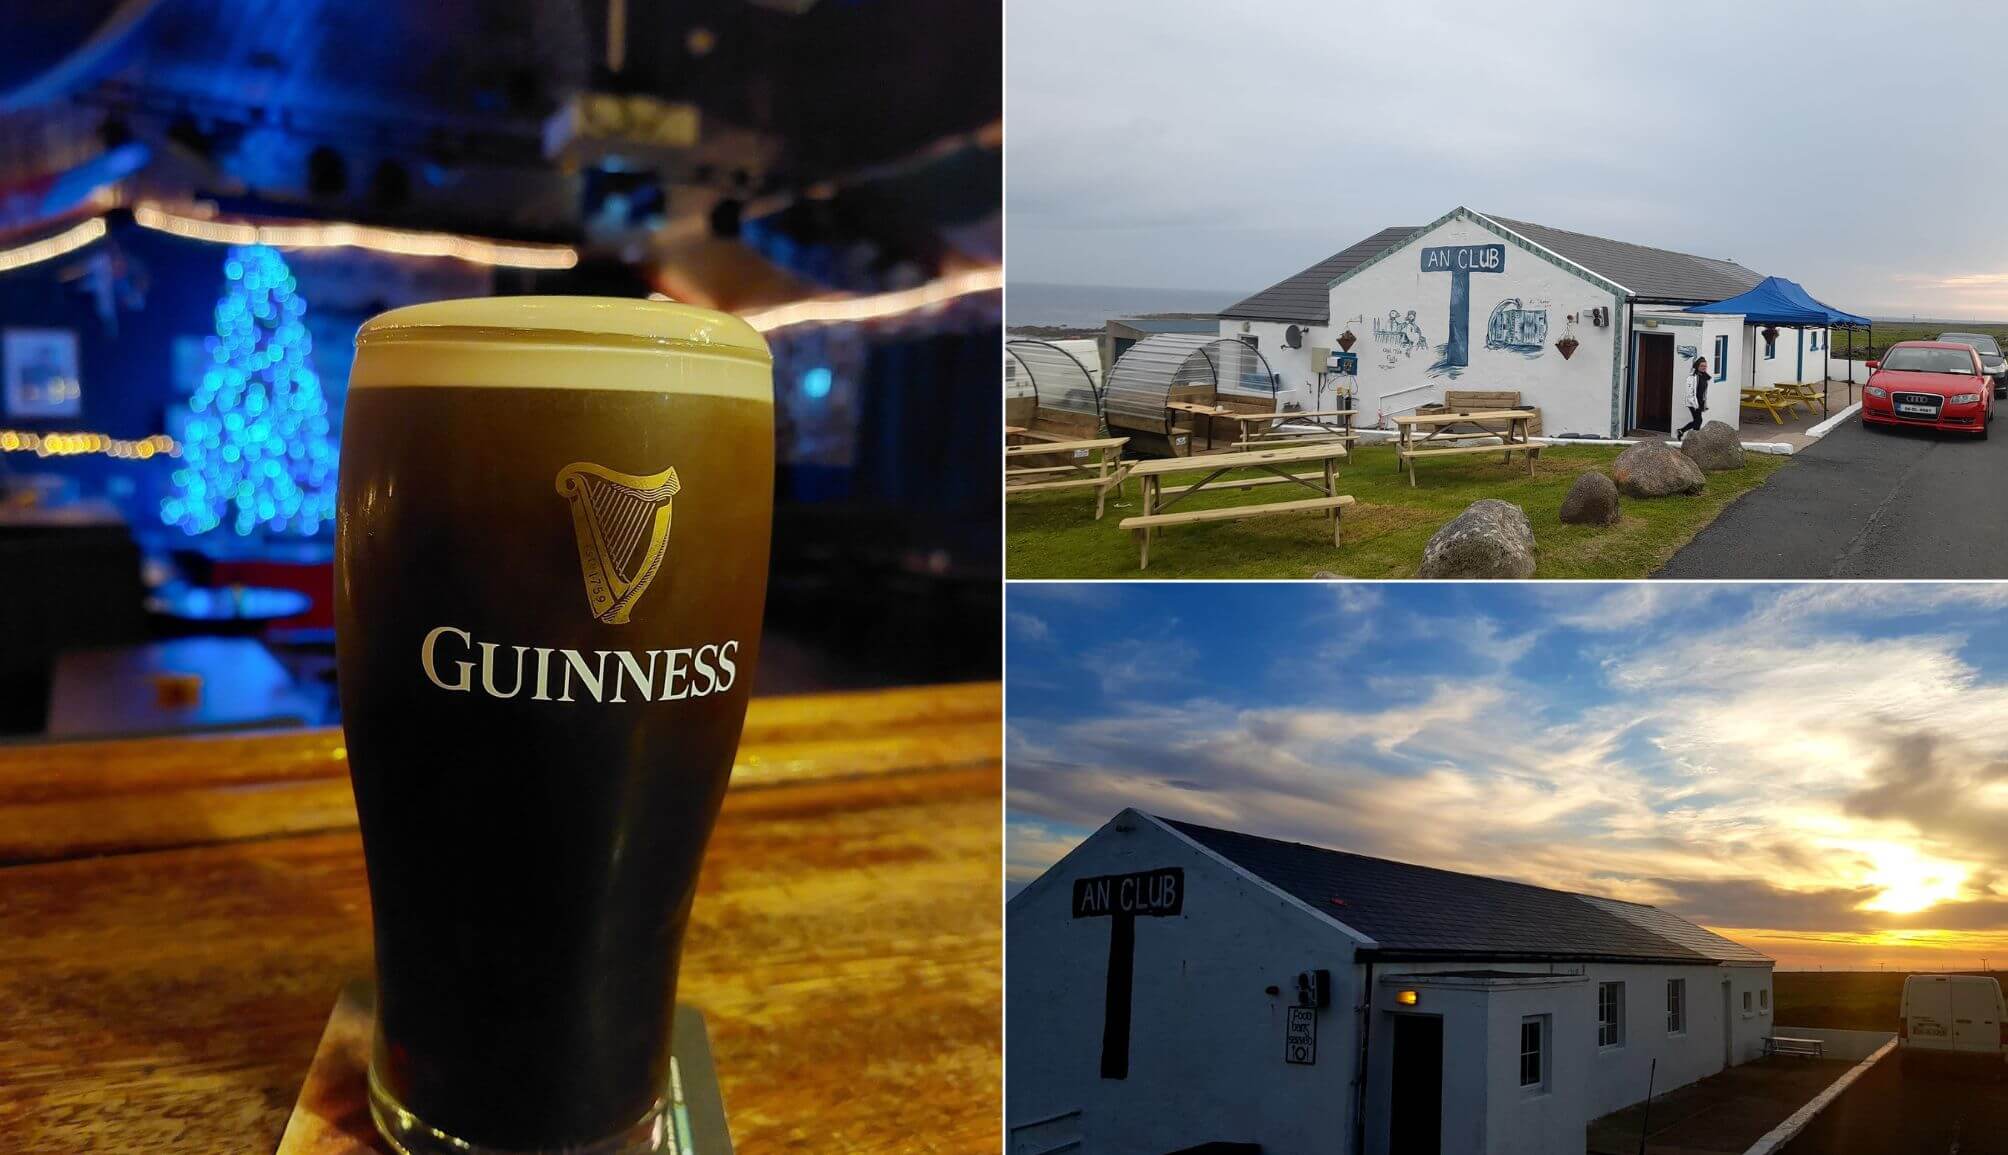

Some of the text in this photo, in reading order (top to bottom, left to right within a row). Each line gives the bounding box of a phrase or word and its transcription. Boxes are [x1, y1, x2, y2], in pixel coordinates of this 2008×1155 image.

[1427, 247, 1500, 269] AN CLUB
[588, 569, 607, 604] 1759
[420, 626, 739, 704] GUINNESS
[1081, 874, 1177, 912] AN CLUB
